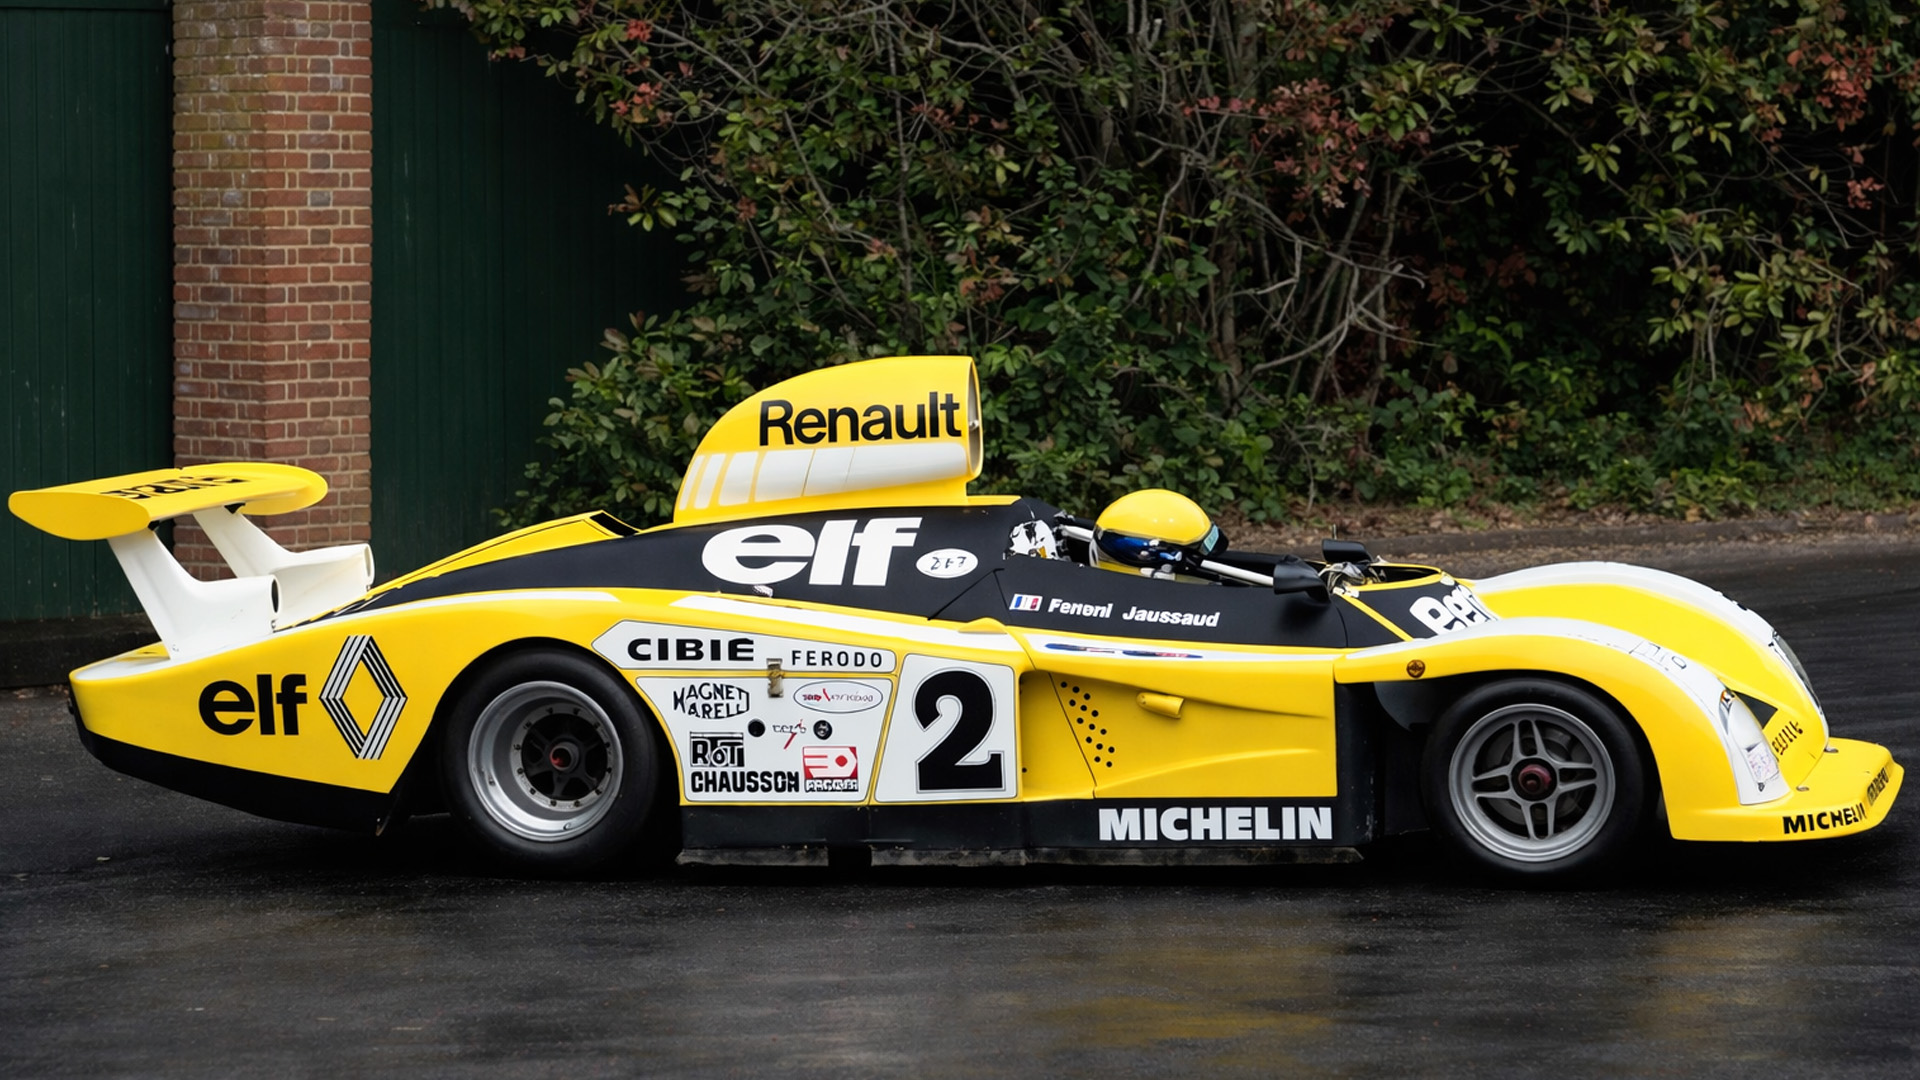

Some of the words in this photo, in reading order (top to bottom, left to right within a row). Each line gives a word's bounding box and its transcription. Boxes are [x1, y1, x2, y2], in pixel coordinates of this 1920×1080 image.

[759, 391, 962, 446] Renault
[701, 517, 923, 587] elf
[1122, 606, 1220, 627] Jaussaud
[791, 650, 882, 667] FERODO
[198, 673, 307, 736] elf
[914, 670, 1004, 791] 2
[1098, 806, 1333, 842] MICHELIN
